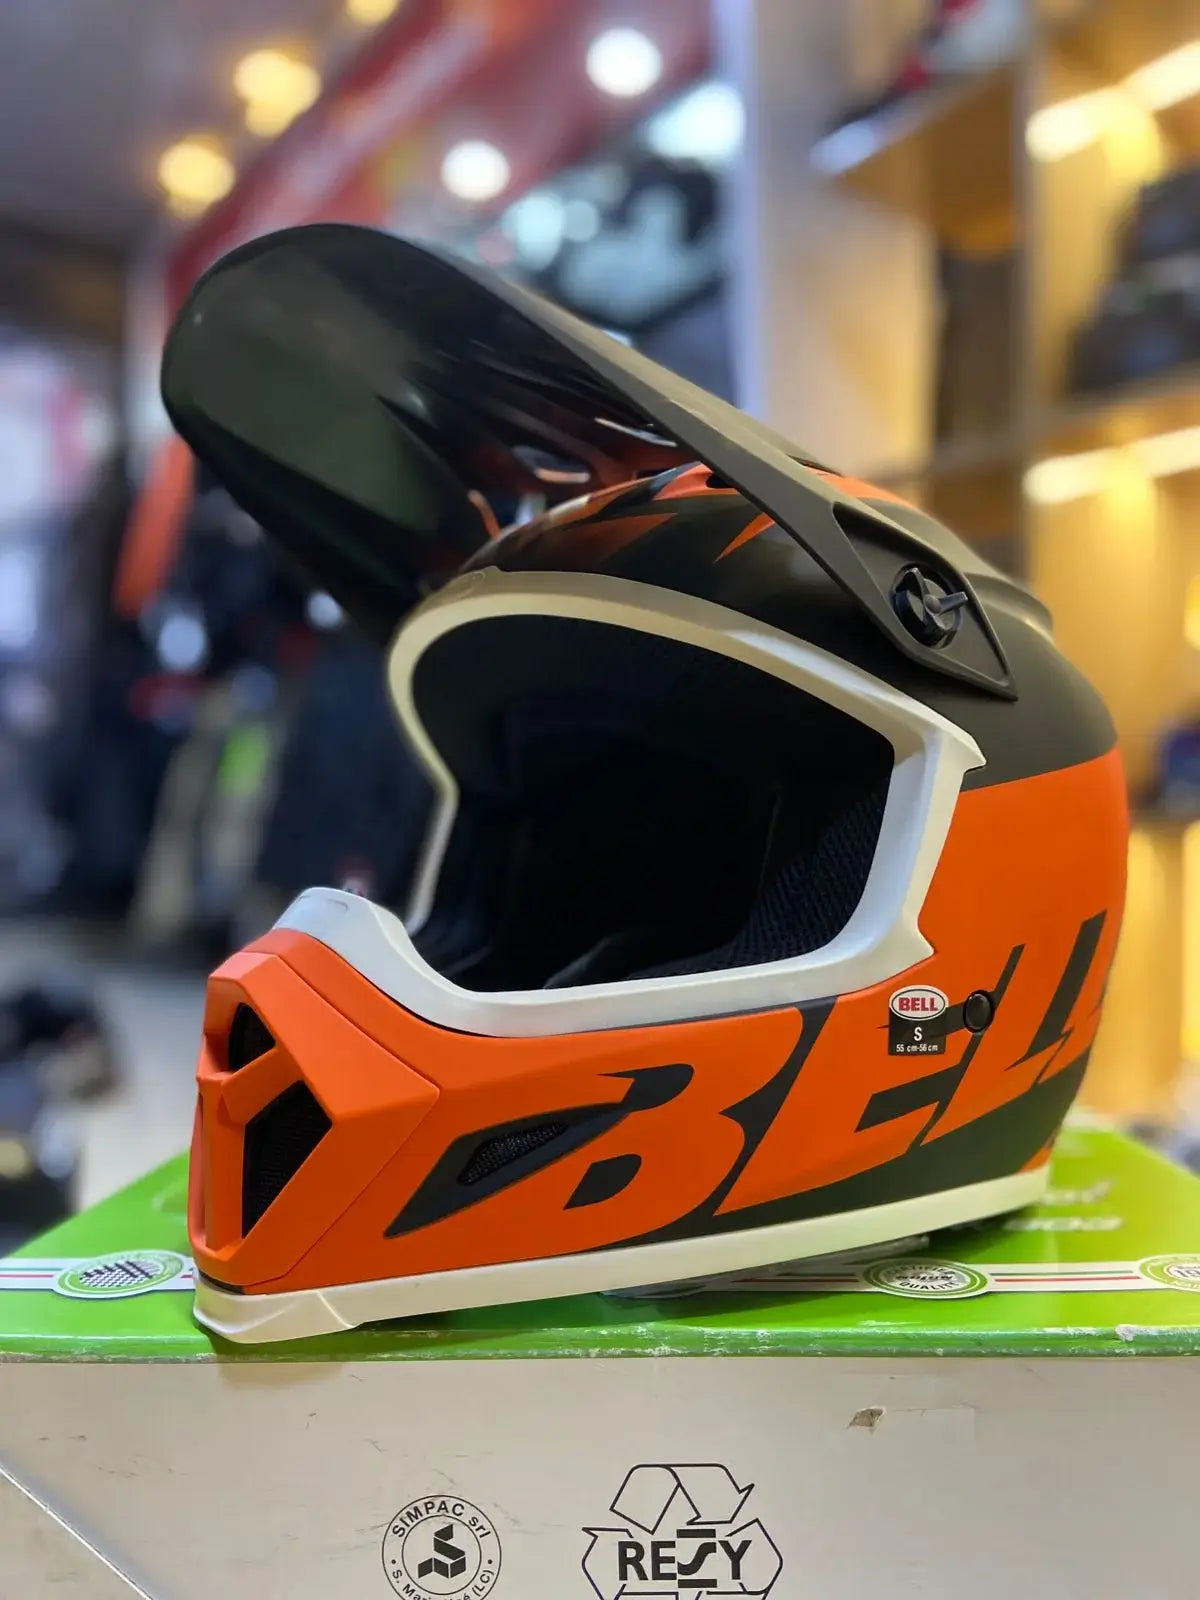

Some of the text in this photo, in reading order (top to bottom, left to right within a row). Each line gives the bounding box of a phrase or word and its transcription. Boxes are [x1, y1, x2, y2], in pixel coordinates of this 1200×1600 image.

[898, 997, 939, 1011] BELL
[913, 1026, 923, 1041] S
[896, 1043, 905, 1052] 55
[392, 1500, 491, 1538] SIMPAC srl
[617, 1532, 753, 1585] RESY
[471, 1569, 495, 1597] (LC)
